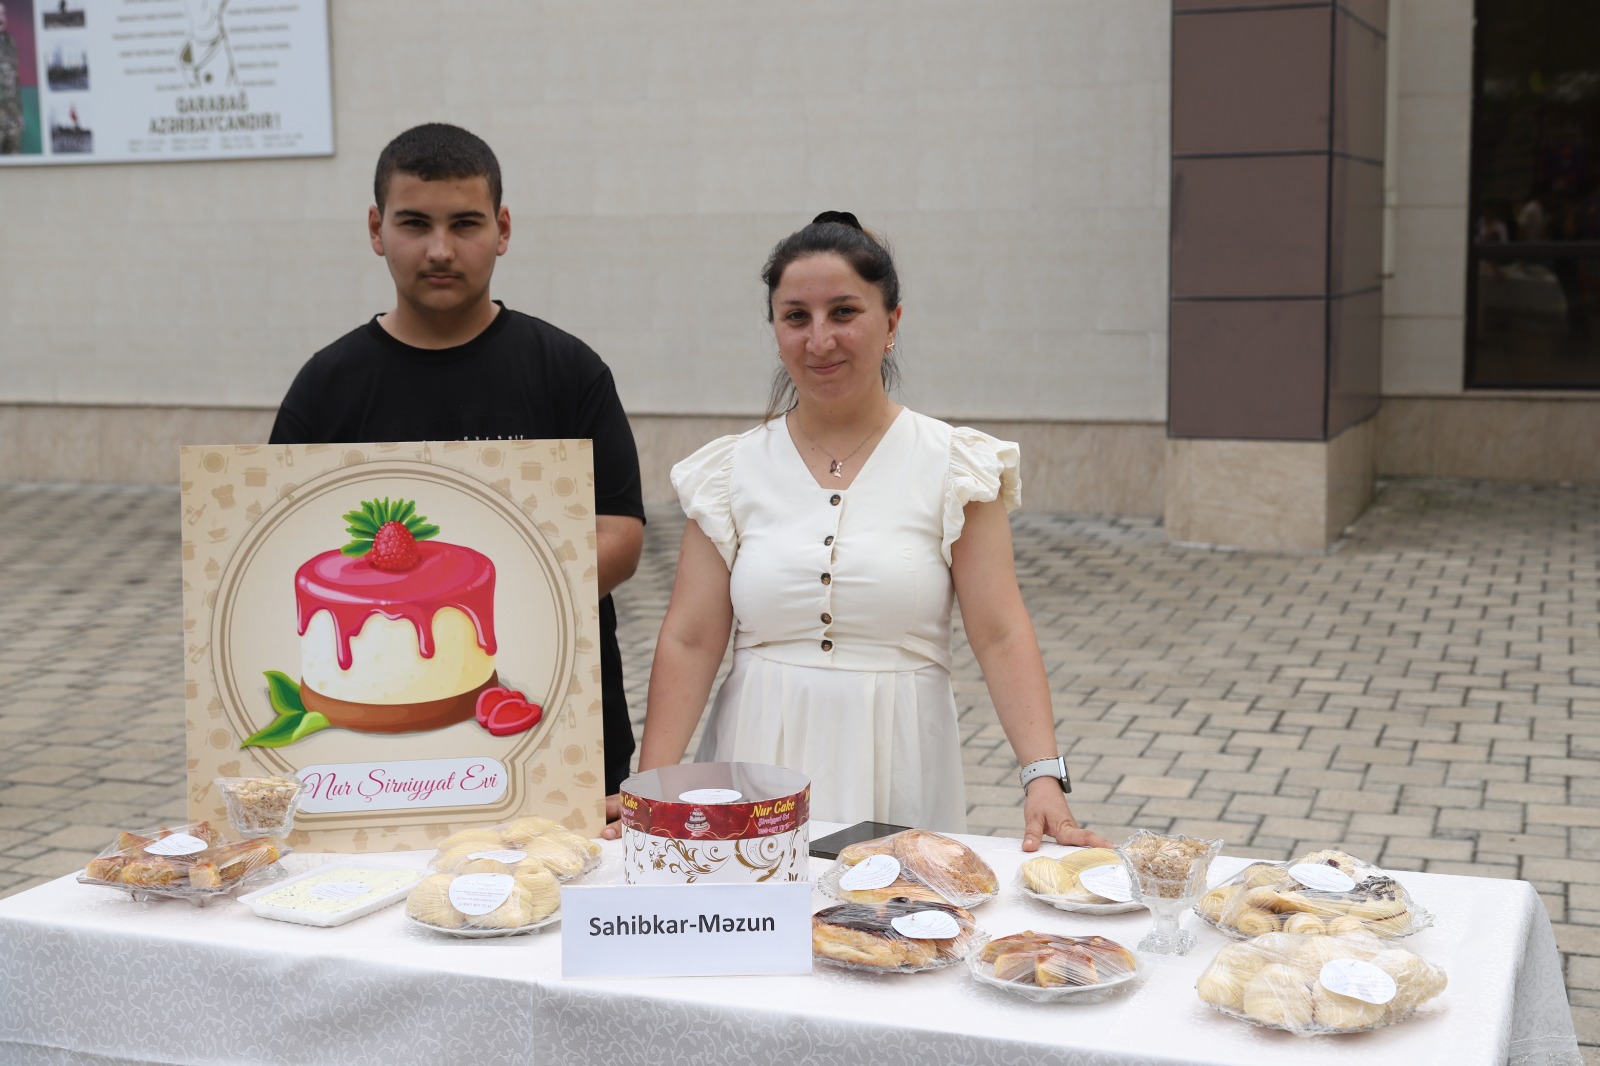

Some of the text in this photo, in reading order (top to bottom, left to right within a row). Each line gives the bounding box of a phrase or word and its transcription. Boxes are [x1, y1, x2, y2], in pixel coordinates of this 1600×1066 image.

[302, 764, 499, 803] Nur Şirniyyat Evi
[750, 799, 796, 818] Nur Cake
[589, 913, 776, 937] Sahibkar-Məzun
